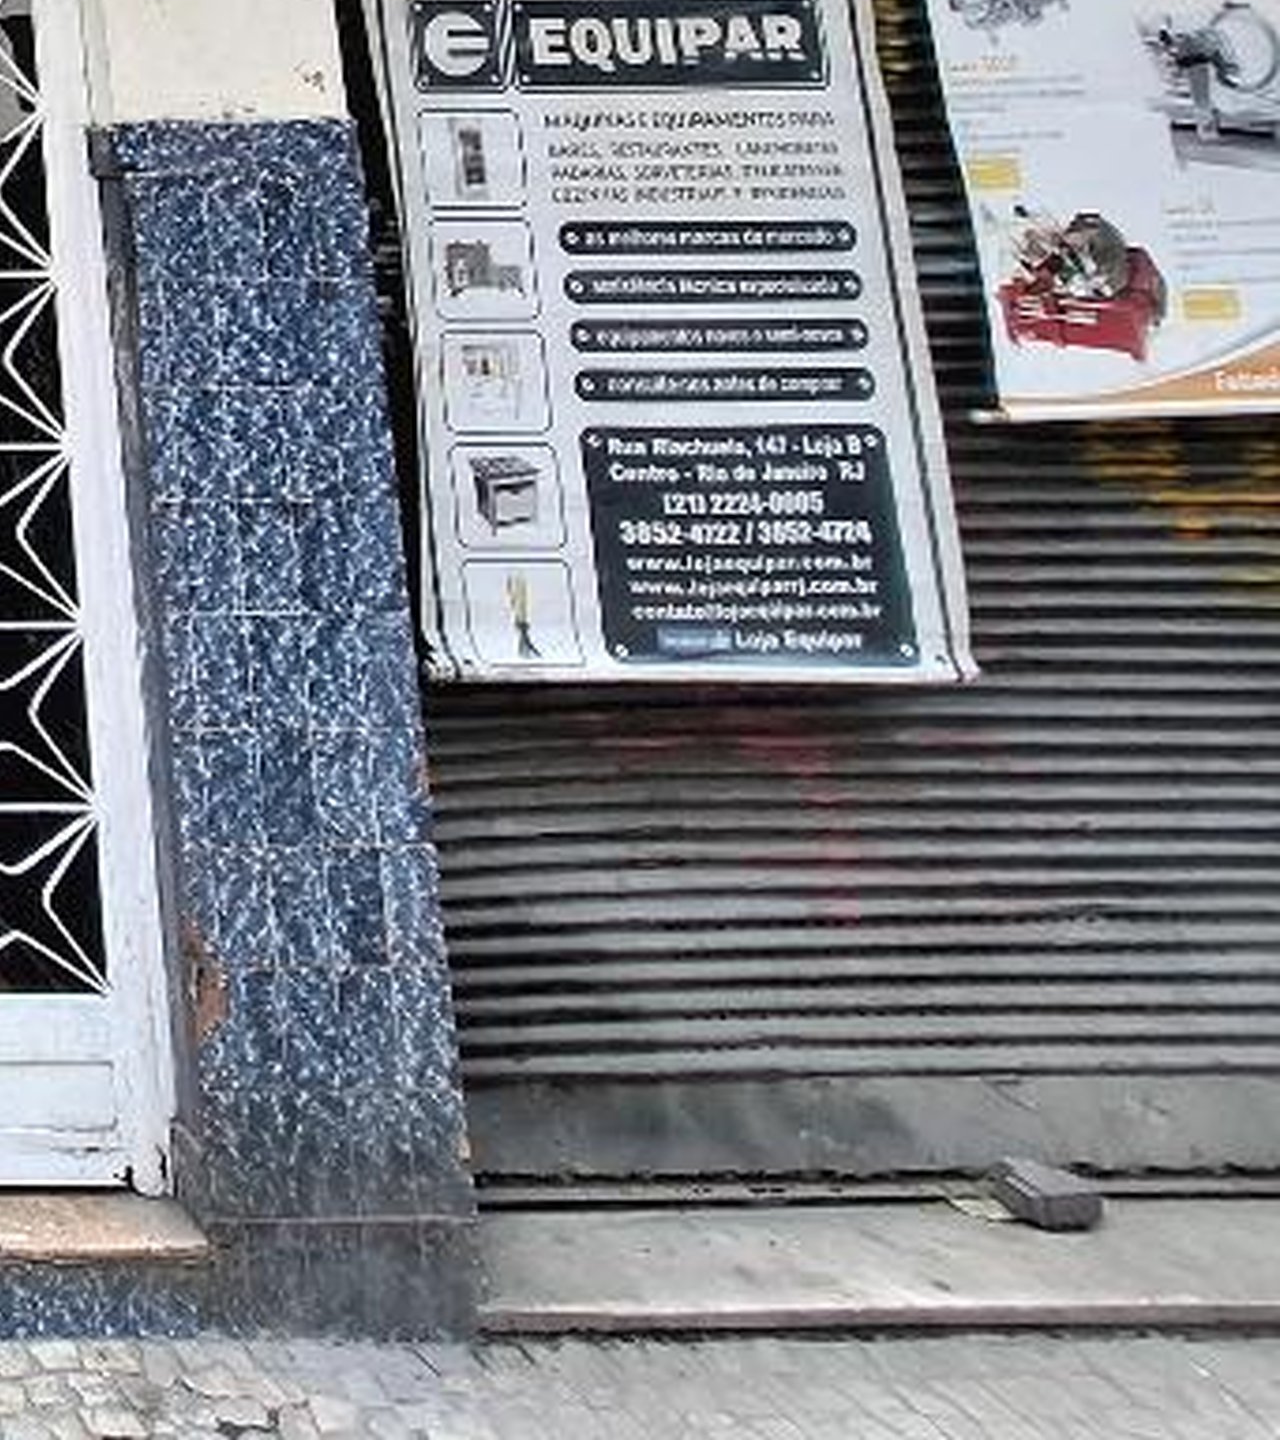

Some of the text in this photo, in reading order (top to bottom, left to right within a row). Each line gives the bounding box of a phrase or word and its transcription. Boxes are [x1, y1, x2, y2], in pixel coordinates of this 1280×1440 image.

[527, 14, 807, 71] EQUIPAR
[608, 438, 647, 456] Rua
[803, 436, 841, 457] Loja
[847, 436, 862, 453] B
[609, 463, 679, 481] Centro
[697, 462, 727, 481] Rio
[762, 462, 828, 481] Janeiro
[663, 493, 705, 514] (21)
[736, 632, 780, 651] Loja
[783, 631, 862, 652] Equipar
